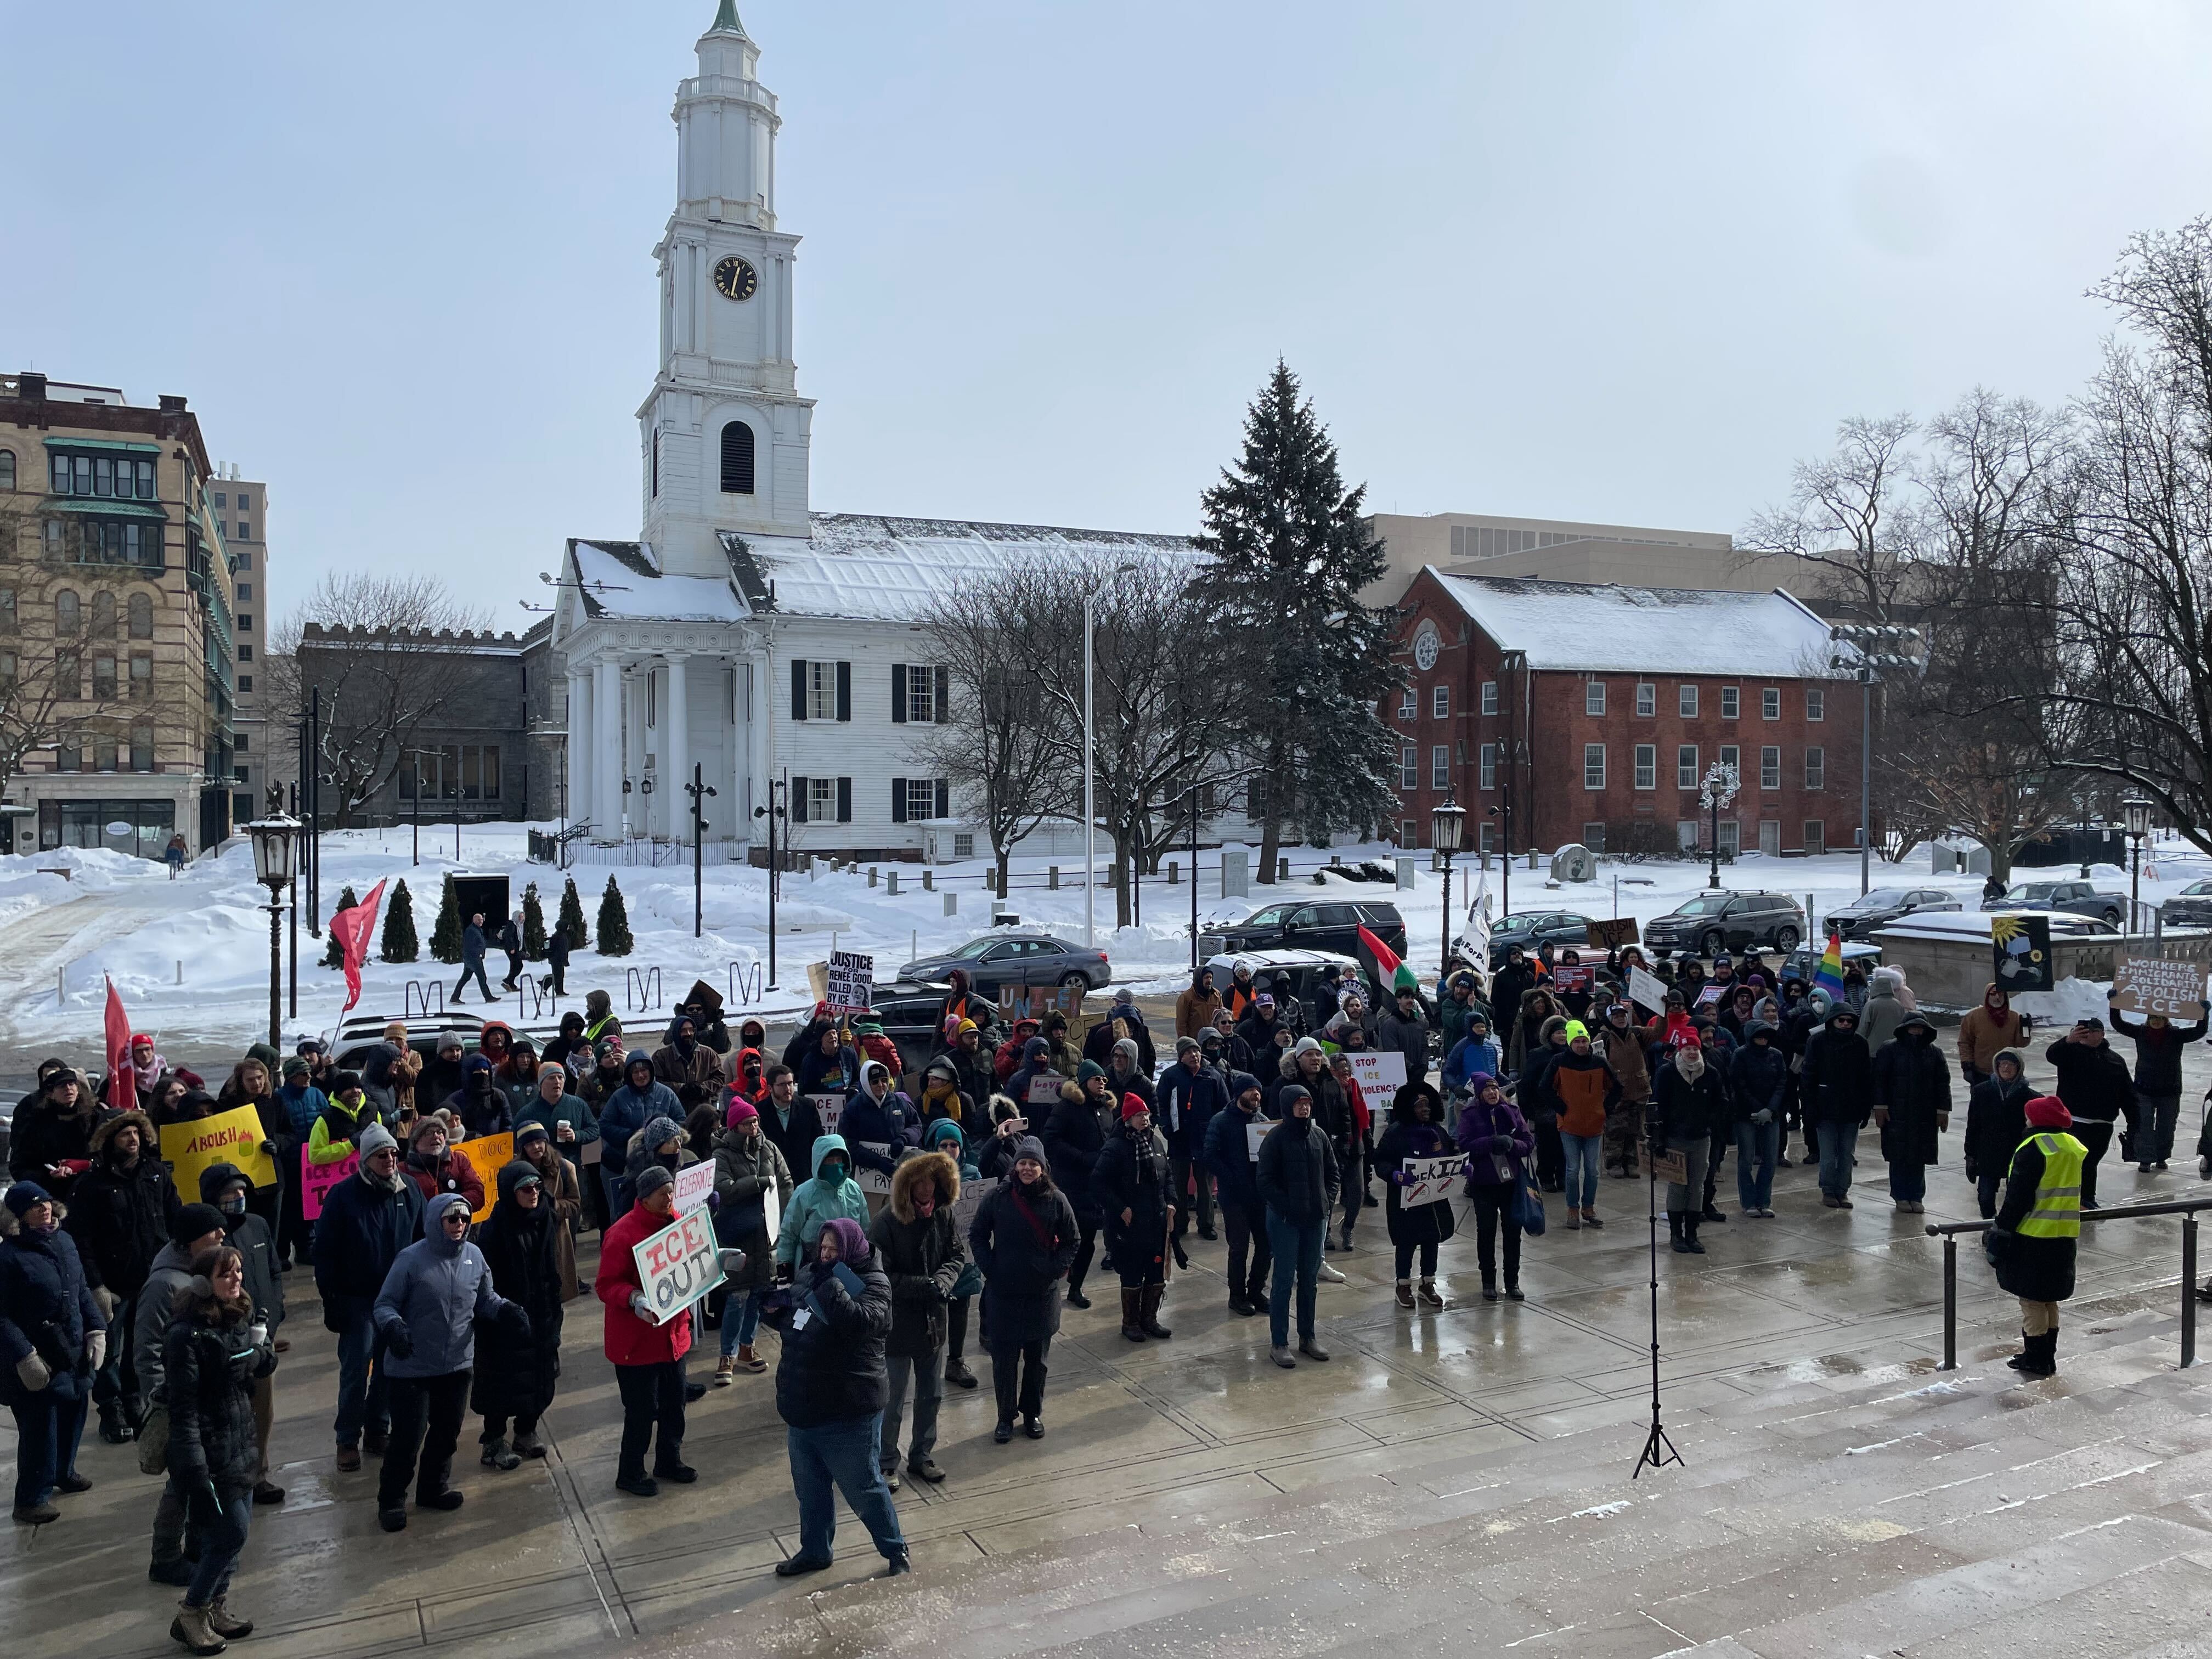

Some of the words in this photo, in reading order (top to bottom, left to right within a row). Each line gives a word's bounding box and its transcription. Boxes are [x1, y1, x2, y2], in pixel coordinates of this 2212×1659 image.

[1591, 919, 1632, 935] ABOLISH
[1603, 931, 1626, 946] ICE
[831, 951, 872, 970] JUSTICE
[2128, 958, 2197, 973] WORKERS
[829, 970, 851, 982] RENEE
[853, 973, 872, 984] GOOD
[2118, 966, 2199, 981] IMMIGRANTS
[828, 981, 851, 994] KILLED
[2130, 976, 2204, 990] SOLIDARITY
[827, 992, 837, 1003] BY
[838, 994, 849, 1005] ICE
[2121, 984, 2199, 1002] ABOLISH
[2134, 996, 2181, 1013] ICE
[1355, 1058, 1376, 1066] STOP
[1364, 1071, 1380, 1080] ICE
[1361, 1084, 1397, 1094] VIOLENCE
[1381, 1099, 1393, 1108] BA
[674, 1165, 714, 1199] CELEBRATE
[646, 1215, 704, 1278] ICE
[656, 1244, 711, 1310] OUT
